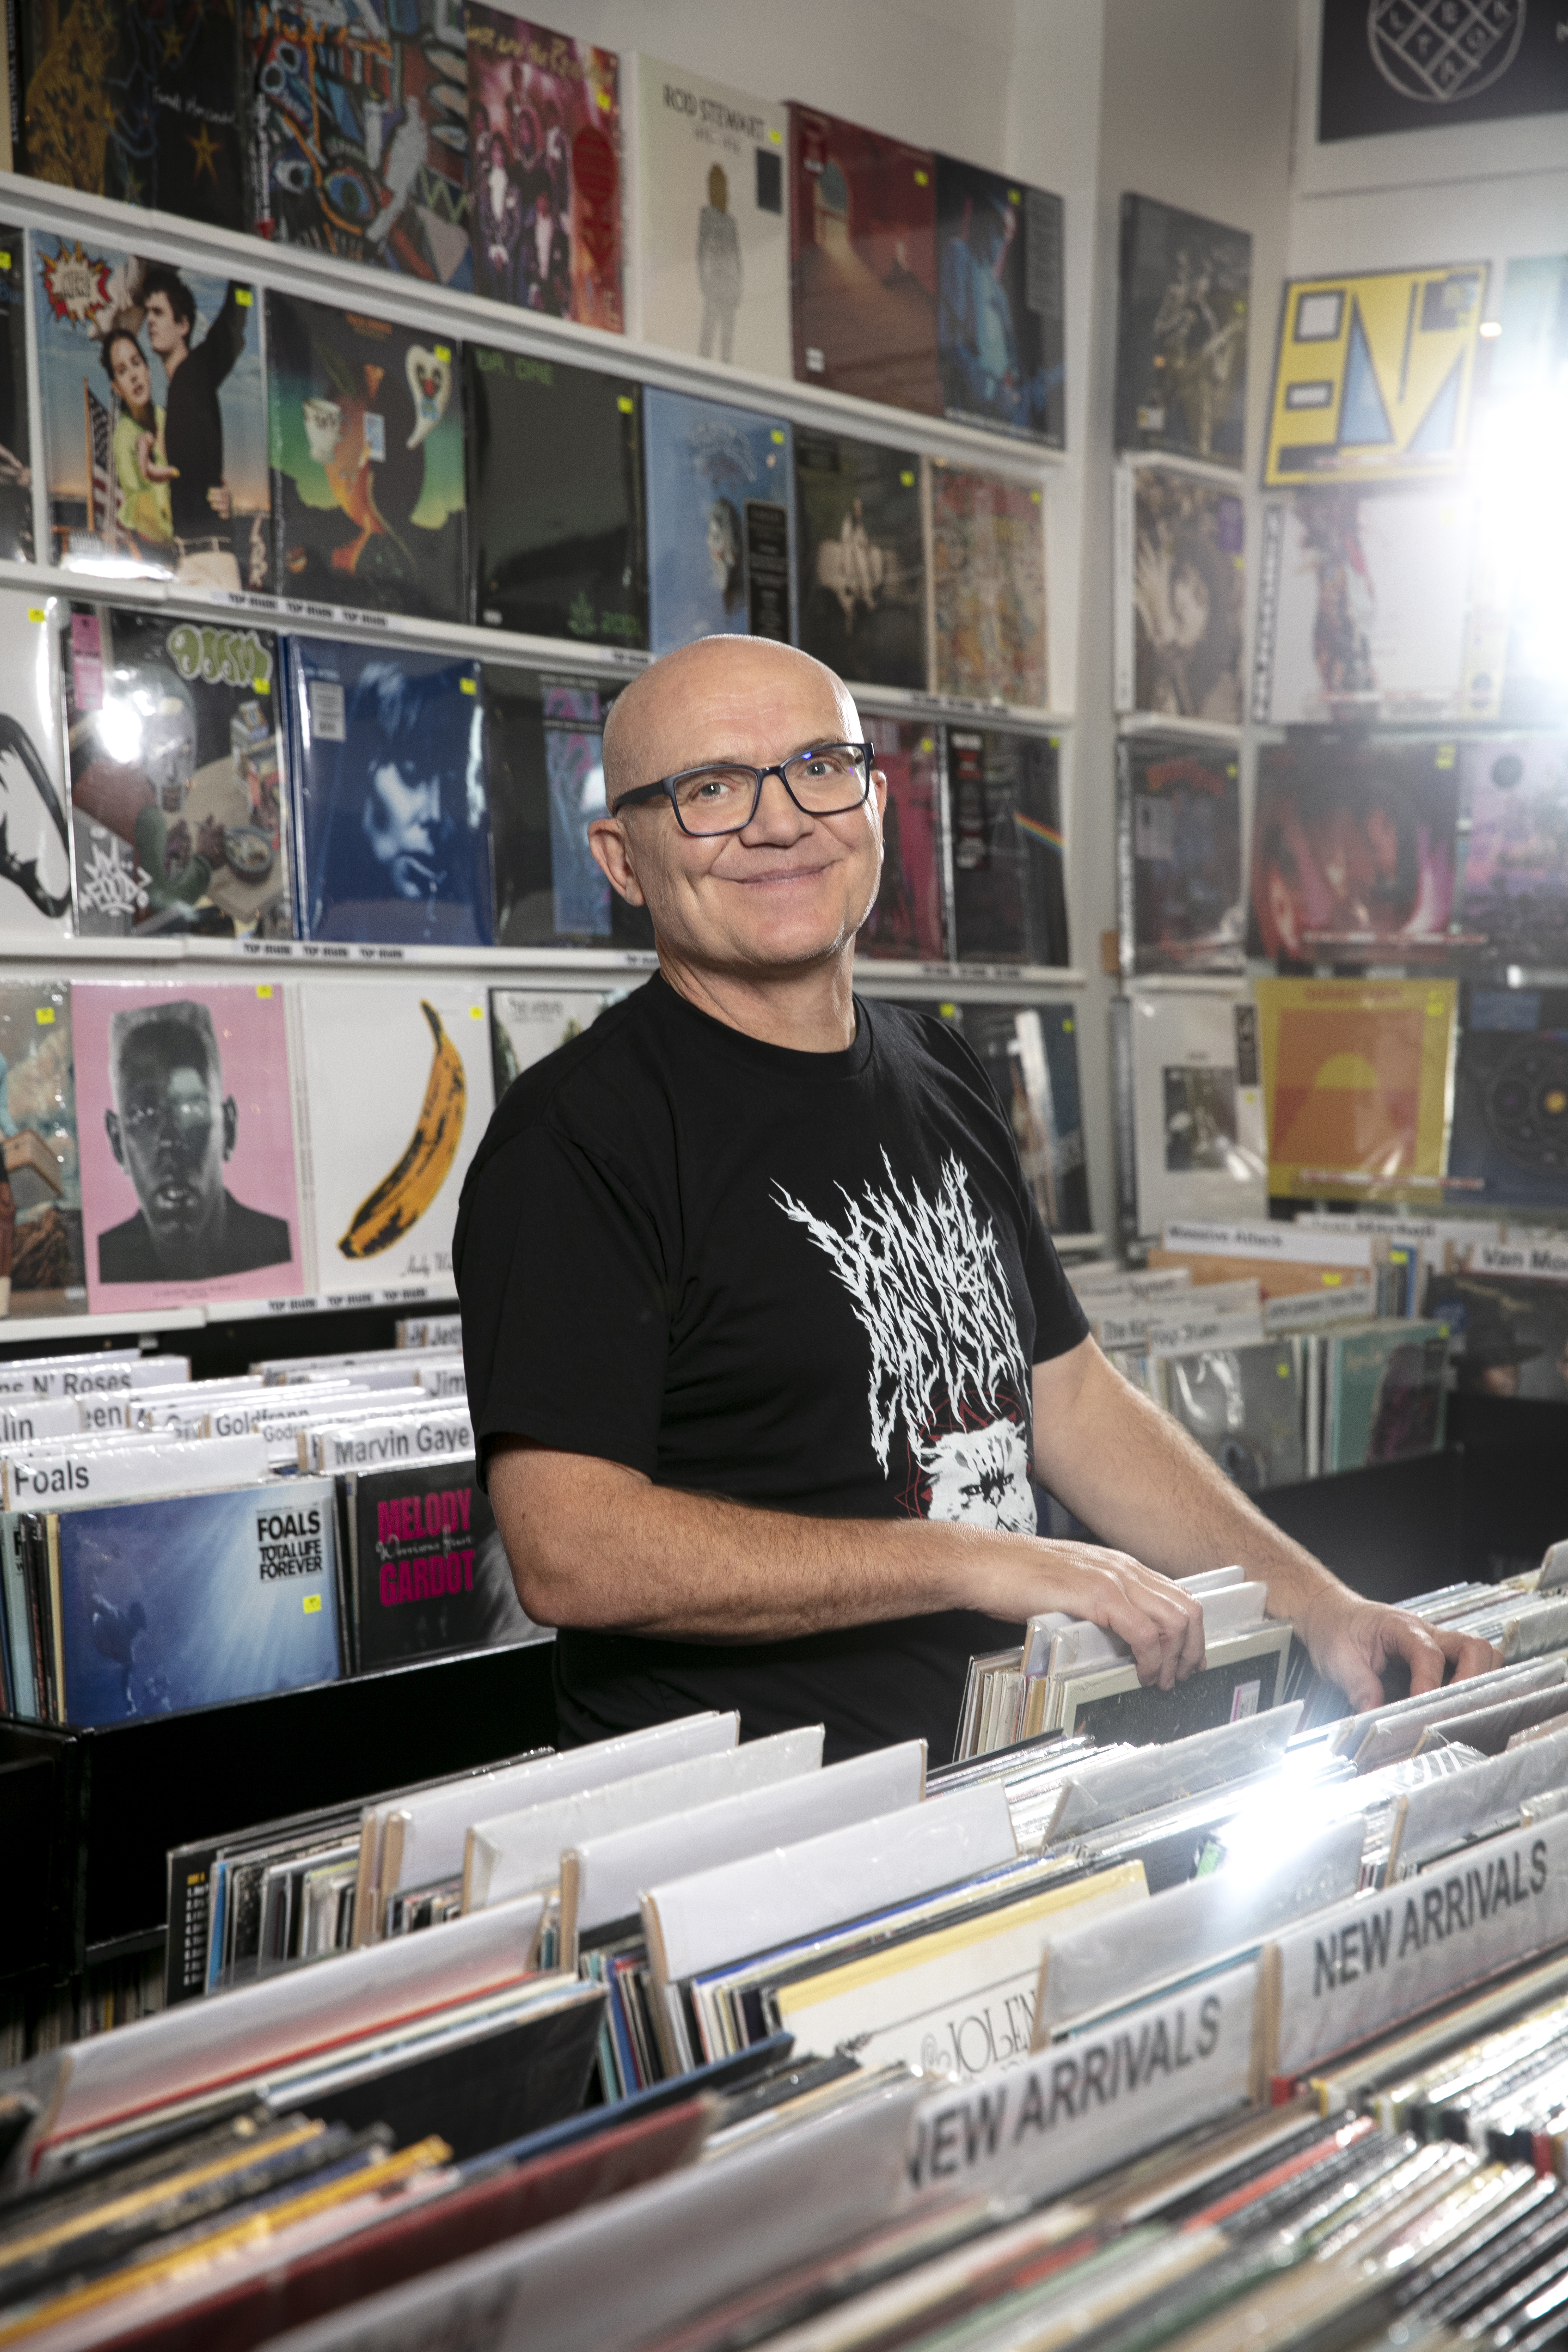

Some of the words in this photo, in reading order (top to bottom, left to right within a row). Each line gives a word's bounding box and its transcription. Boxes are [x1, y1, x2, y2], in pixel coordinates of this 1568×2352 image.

[662, 83, 697, 117] ROD
[699, 97, 765, 142] STEWART
[1168, 1225, 1230, 1245] Massive
[1483, 1246, 1525, 1270] Van
[63, 1371, 132, 1395] Roses
[335, 1429, 410, 1465] Marvin
[416, 1423, 470, 1453] Gaye
[14, 1460, 90, 1496] Foals
[257, 1510, 320, 1542] FOALS
[377, 1487, 472, 1545] MELODY
[259, 1543, 296, 1562] TOTAL
[298, 1539, 322, 1557] LIFE
[260, 1555, 322, 1580] FOREVER
[380, 1548, 475, 1607] GARDOT
[1313, 1908, 1392, 1998] NEW
[1398, 1839, 1549, 1958] ARRIVALS
[1013, 1993, 1222, 2145] ARRIVALS
